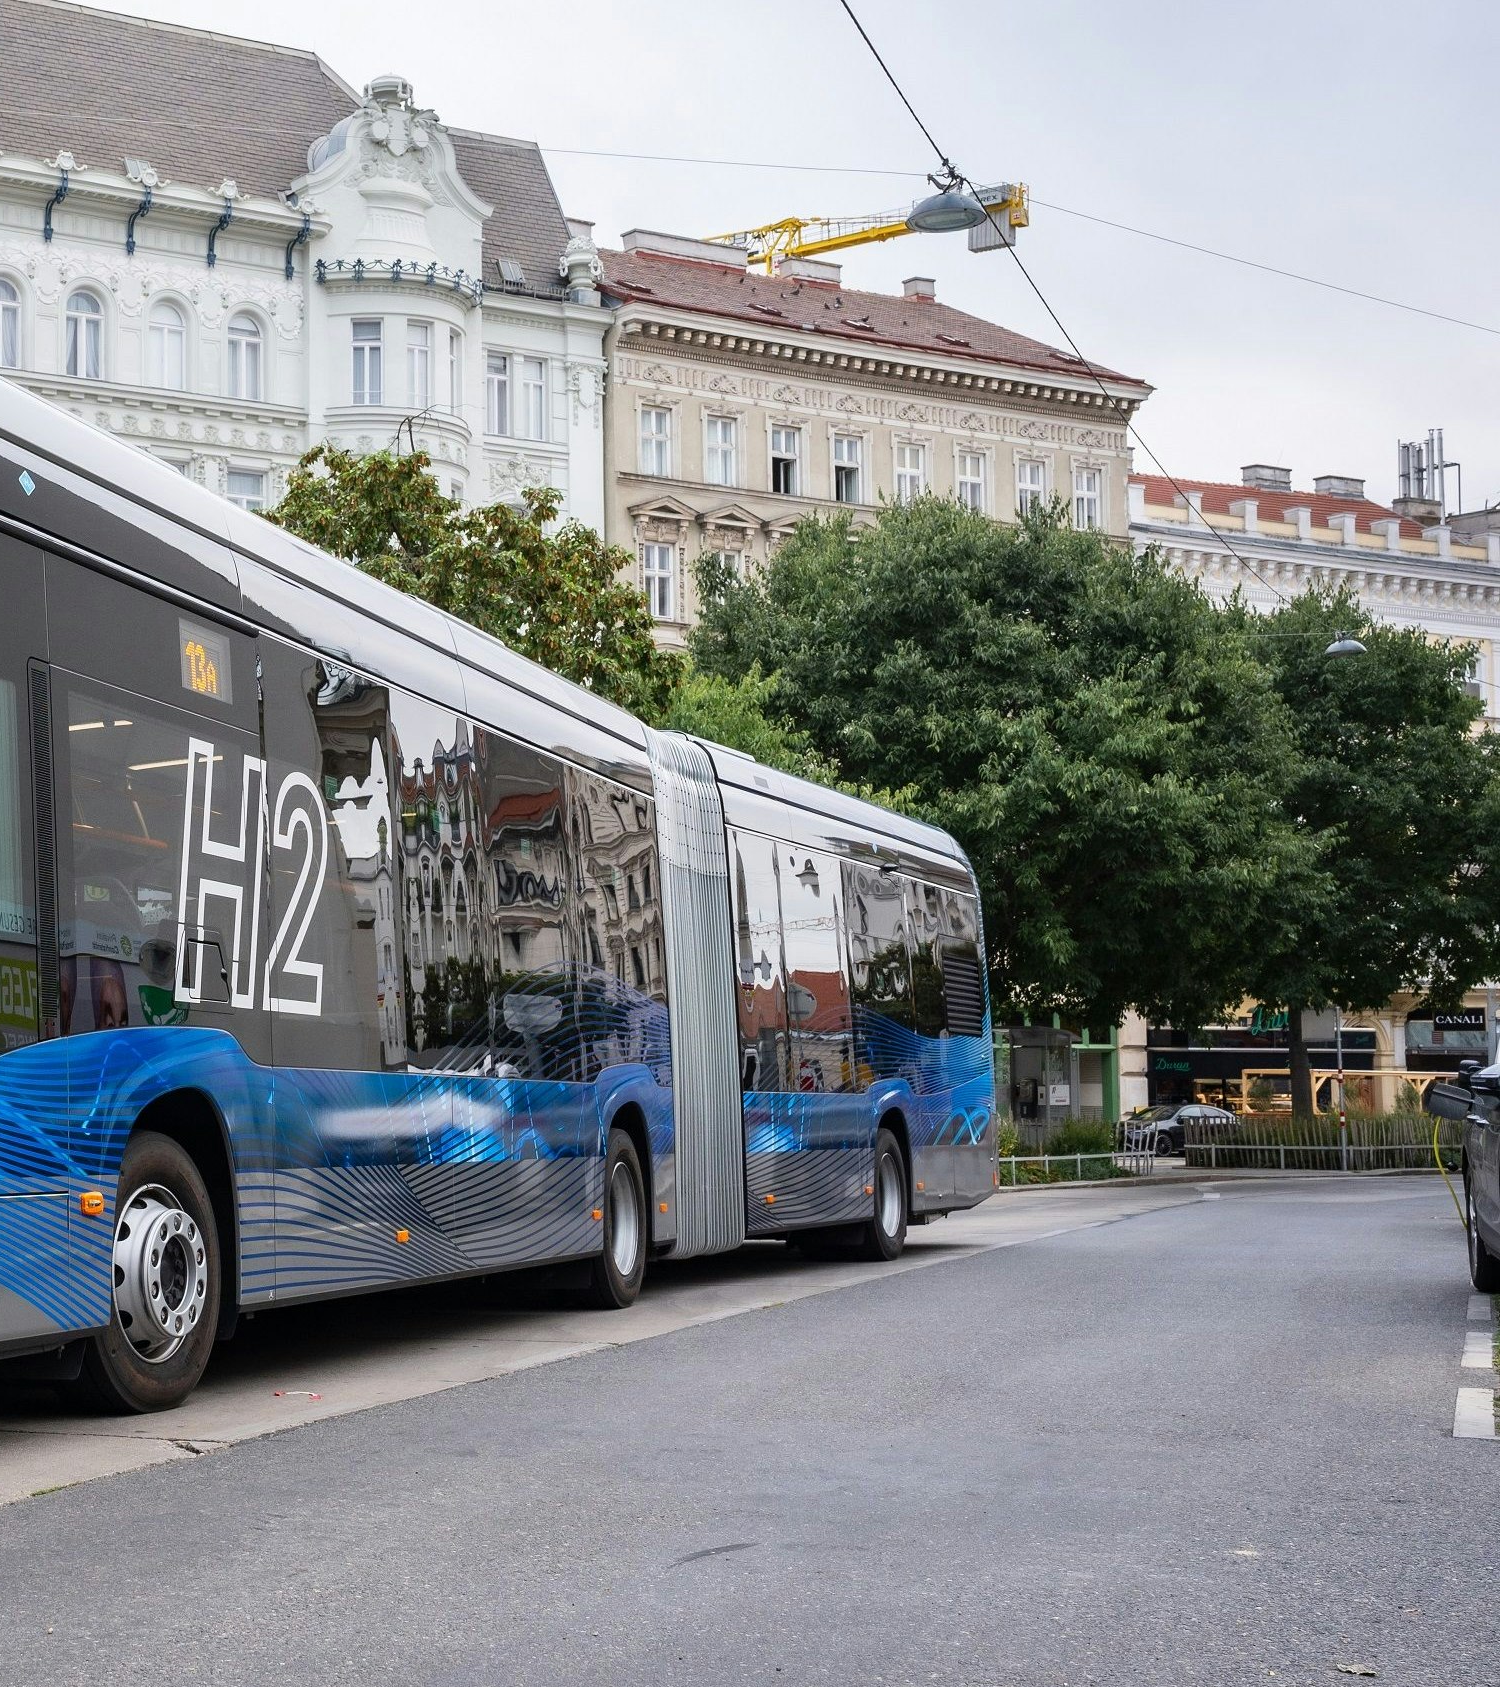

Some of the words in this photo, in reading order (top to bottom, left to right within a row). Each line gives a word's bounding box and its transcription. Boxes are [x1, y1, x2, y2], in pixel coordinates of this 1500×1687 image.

[185, 640, 218, 695] 13A
[175, 737, 329, 1017] H2
[1435, 1015, 1483, 1024] CANALI
